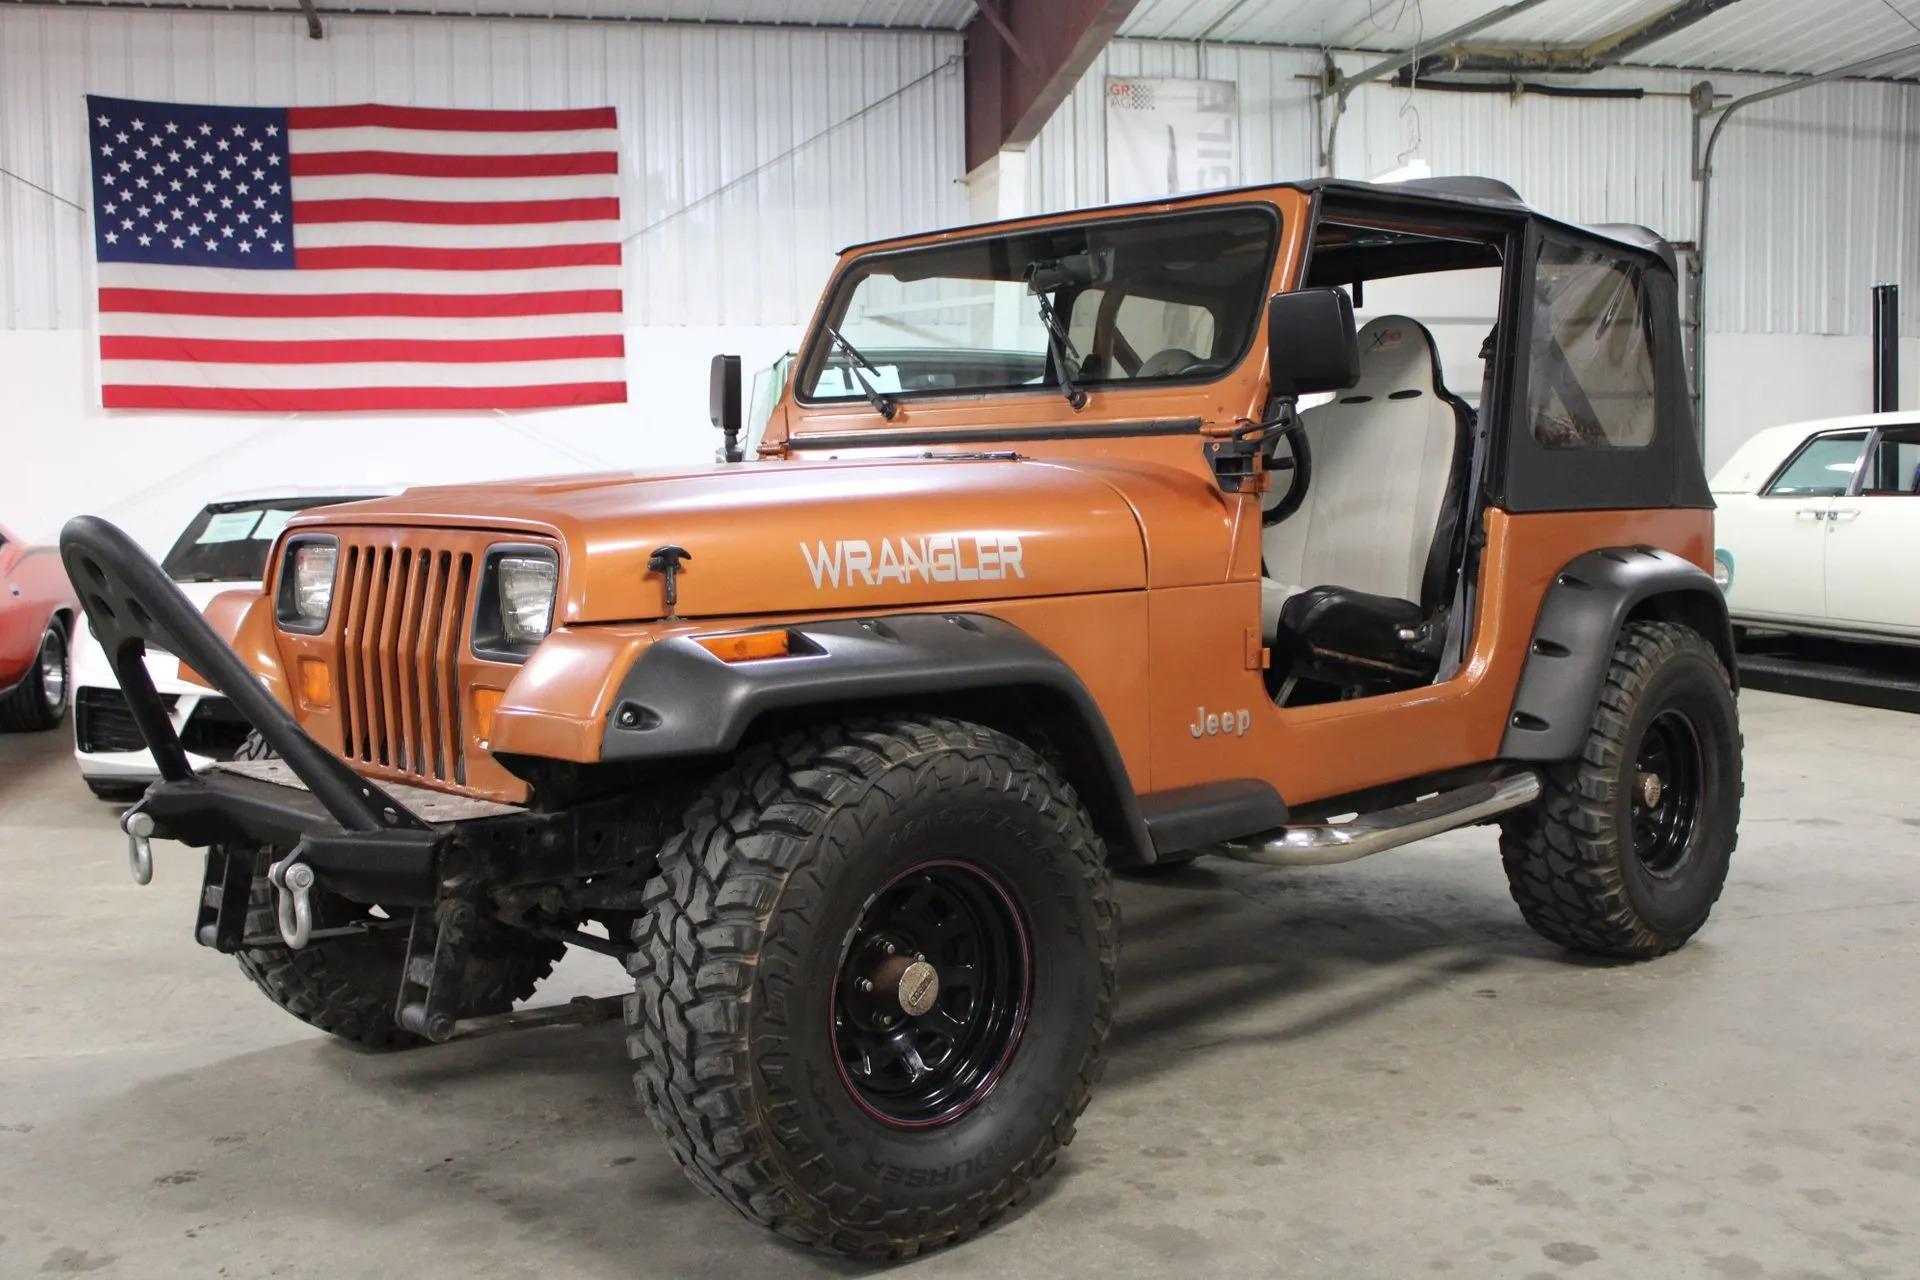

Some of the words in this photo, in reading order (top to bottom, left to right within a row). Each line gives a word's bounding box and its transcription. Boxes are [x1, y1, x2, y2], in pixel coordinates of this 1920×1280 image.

[1110, 84, 1131, 96] GR
[800, 536, 1025, 590] WRANGLER
[1190, 706, 1251, 738] Jeep
